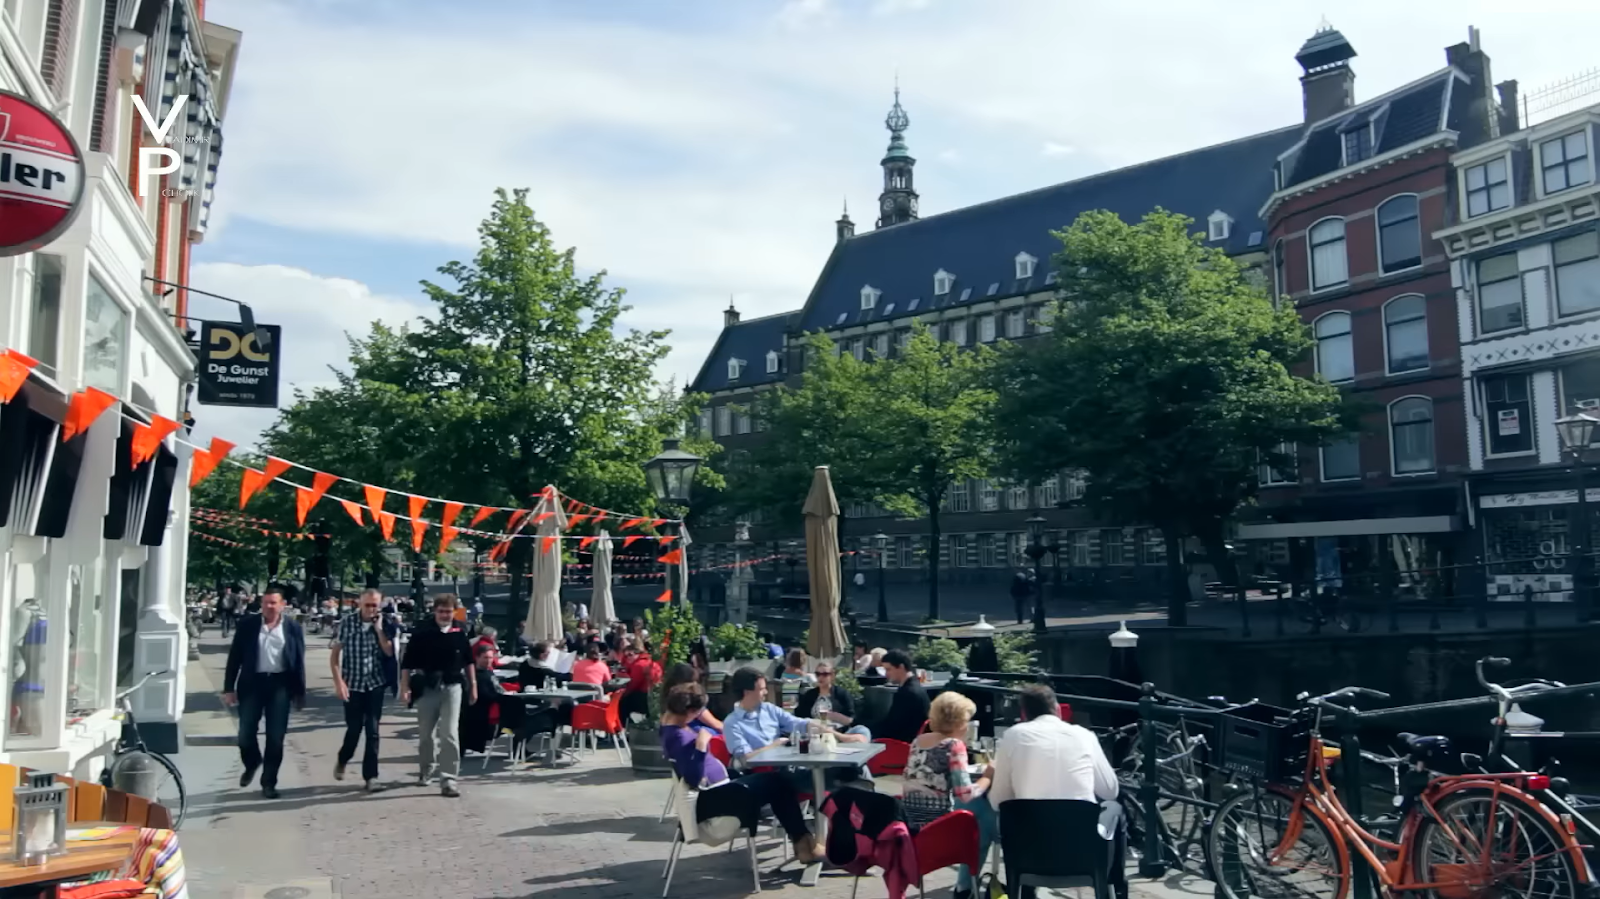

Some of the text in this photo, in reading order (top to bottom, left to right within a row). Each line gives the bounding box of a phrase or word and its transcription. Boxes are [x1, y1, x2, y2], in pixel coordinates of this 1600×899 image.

[208, 364, 269, 376] De Gunst
[217, 375, 259, 384] Juwelier
